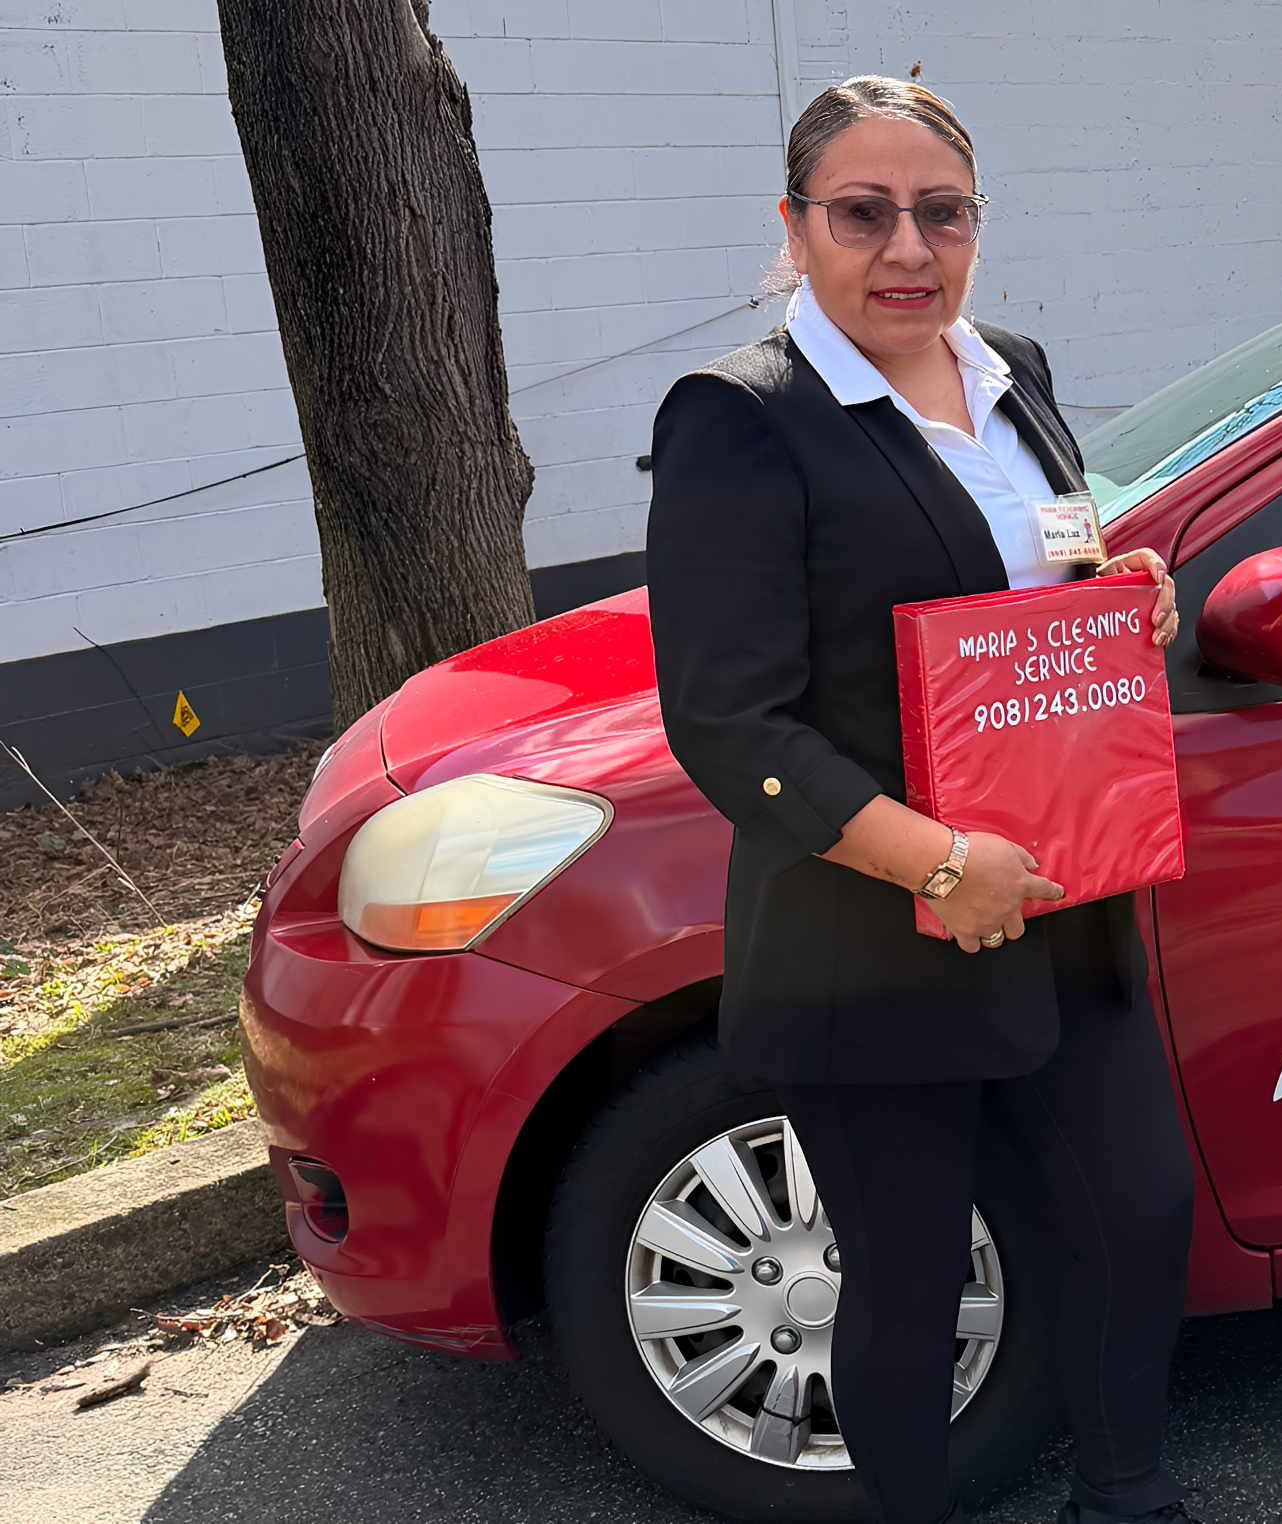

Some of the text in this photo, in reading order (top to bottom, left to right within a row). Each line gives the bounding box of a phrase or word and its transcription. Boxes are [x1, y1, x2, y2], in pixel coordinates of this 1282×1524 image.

[959, 607, 1140, 662] MARIA S CLEANING
[1014, 645, 1098, 685] SERVICE
